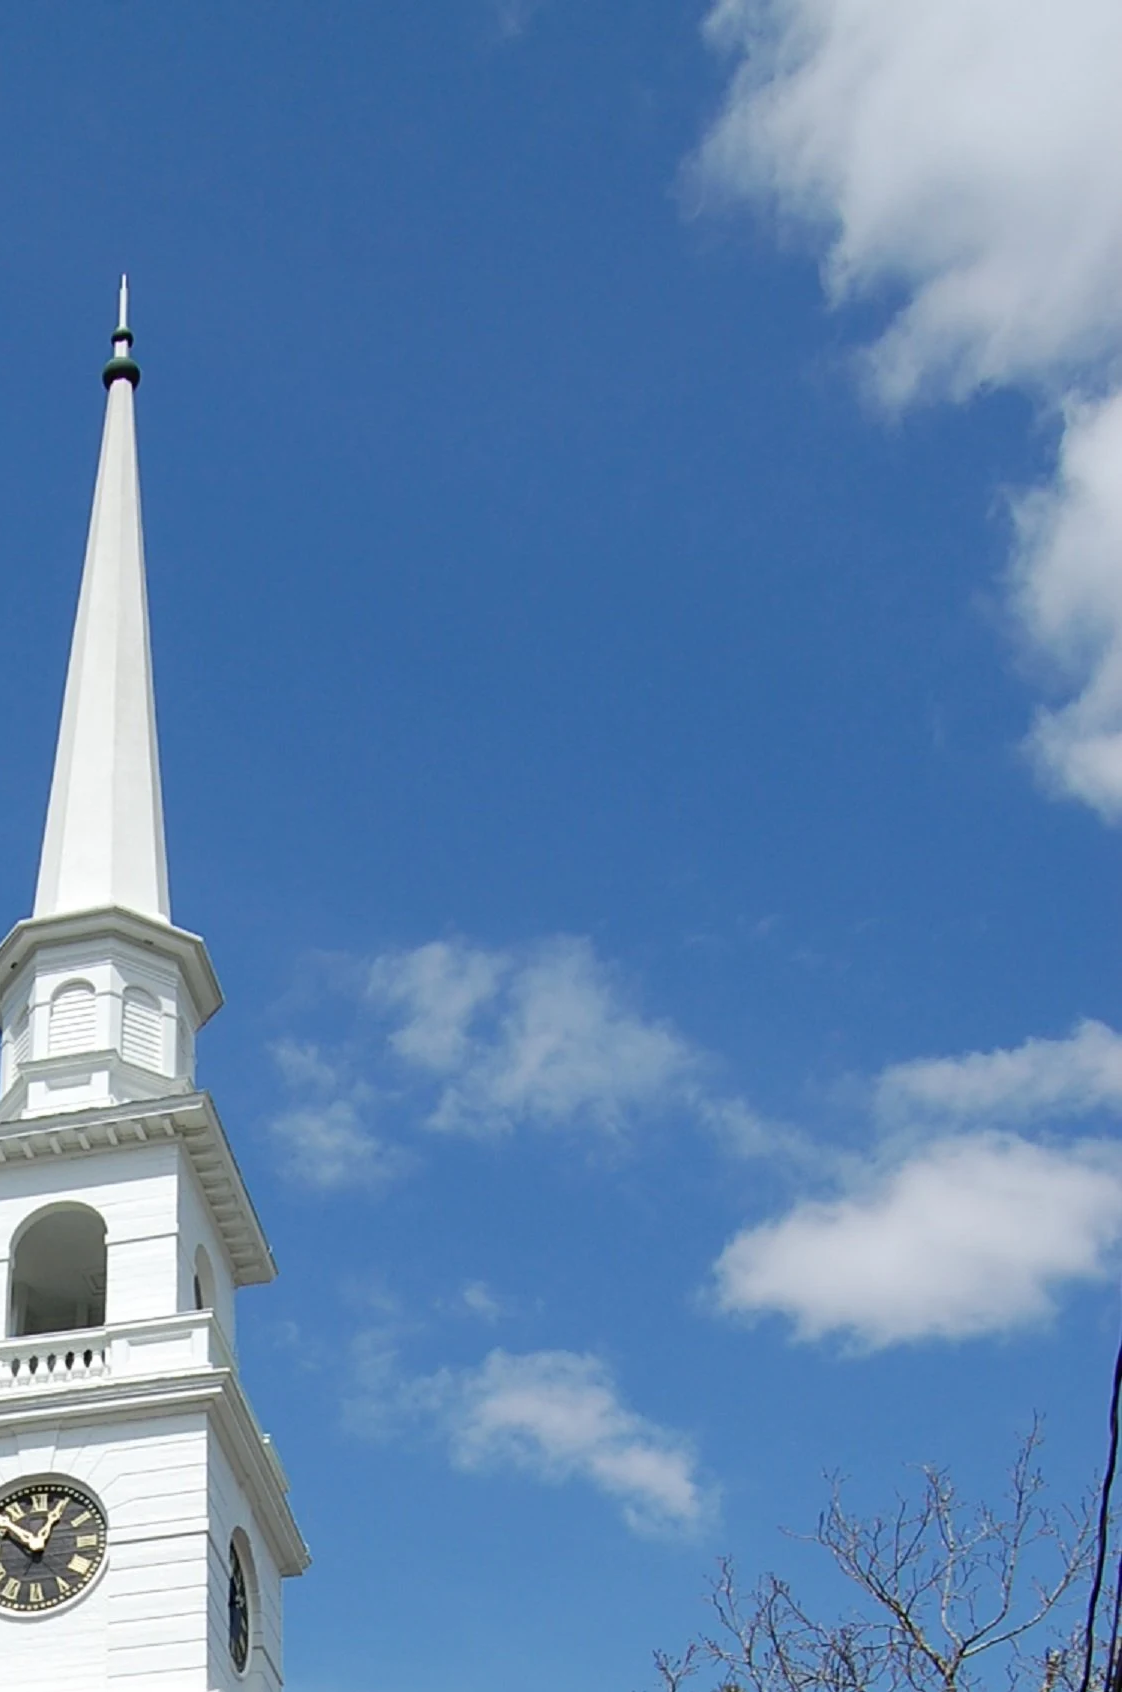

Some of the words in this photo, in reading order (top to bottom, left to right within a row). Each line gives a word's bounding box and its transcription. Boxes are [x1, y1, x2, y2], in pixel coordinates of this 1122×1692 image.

[5, 1502, 26, 1522] XI
[30, 1494, 49, 1512] XII
[71, 1511, 92, 1527] II
[75, 1534, 97, 1548] III
[0, 1577, 22, 1601] VII
[29, 1582, 44, 1602] VI
[55, 1576, 71, 1593] V
